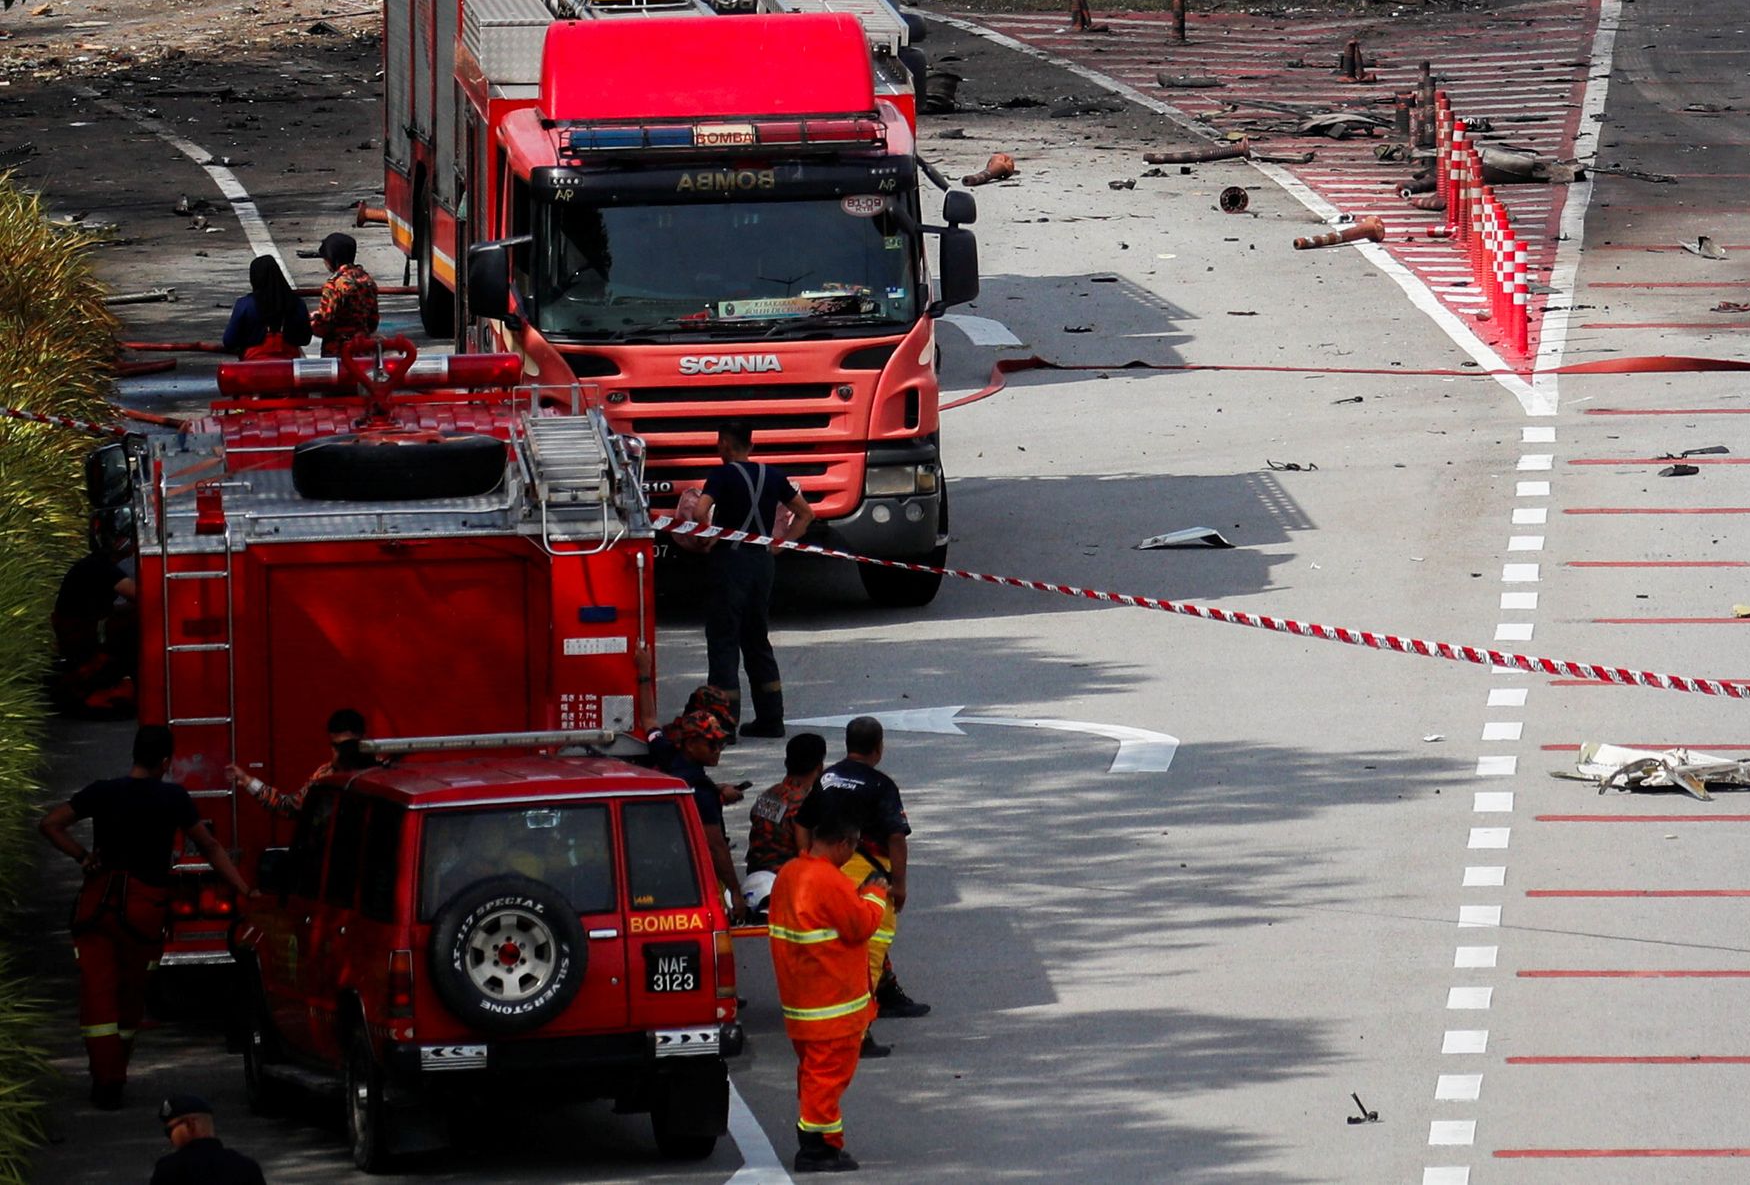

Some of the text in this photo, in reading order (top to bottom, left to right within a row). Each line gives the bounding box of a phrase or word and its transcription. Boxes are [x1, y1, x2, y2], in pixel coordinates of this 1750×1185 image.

[696, 131, 753, 144] BOMBA
[679, 353, 783, 375] SCANIA
[475, 896, 546, 915] SPECIAL
[630, 913, 704, 933] BOMBA
[658, 956, 689, 974] NAF
[479, 957, 570, 1015] SILVERSTONE
[653, 973, 694, 991] 3123
